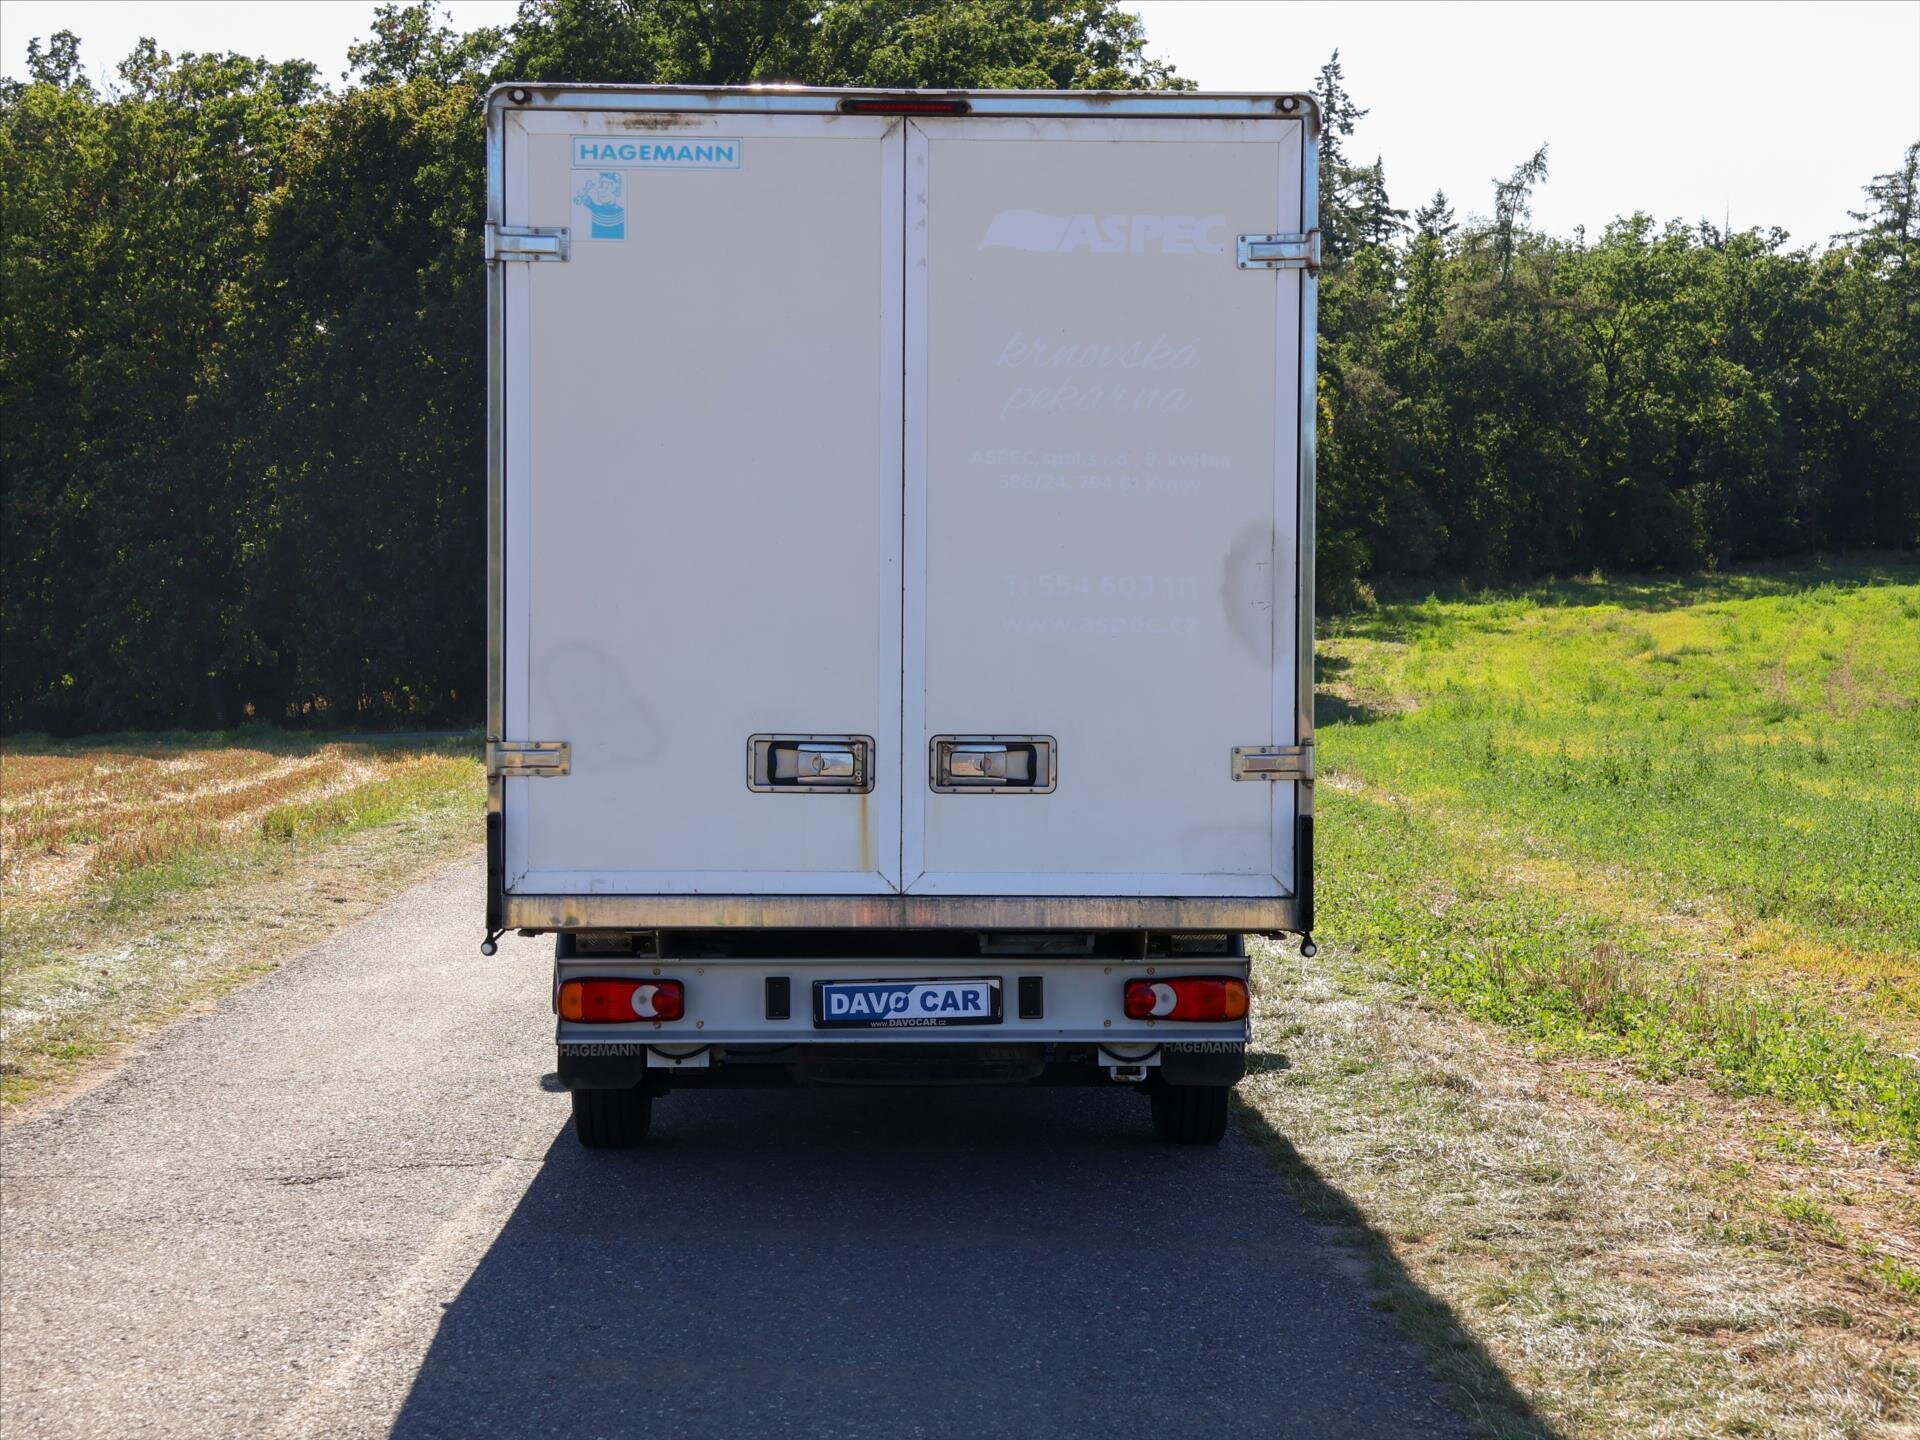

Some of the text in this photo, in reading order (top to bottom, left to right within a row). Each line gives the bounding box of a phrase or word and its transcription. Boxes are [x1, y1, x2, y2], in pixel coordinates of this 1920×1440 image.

[580, 143, 734, 162] HAGEMANN
[1056, 214, 1226, 254] ASPEC
[830, 989, 983, 1015] DAVO CAR
[870, 1018, 947, 1028] www.DAVOCAR.cz
[559, 1043, 641, 1057] HAGEMANN
[1163, 1041, 1244, 1055] HAGEMANN
